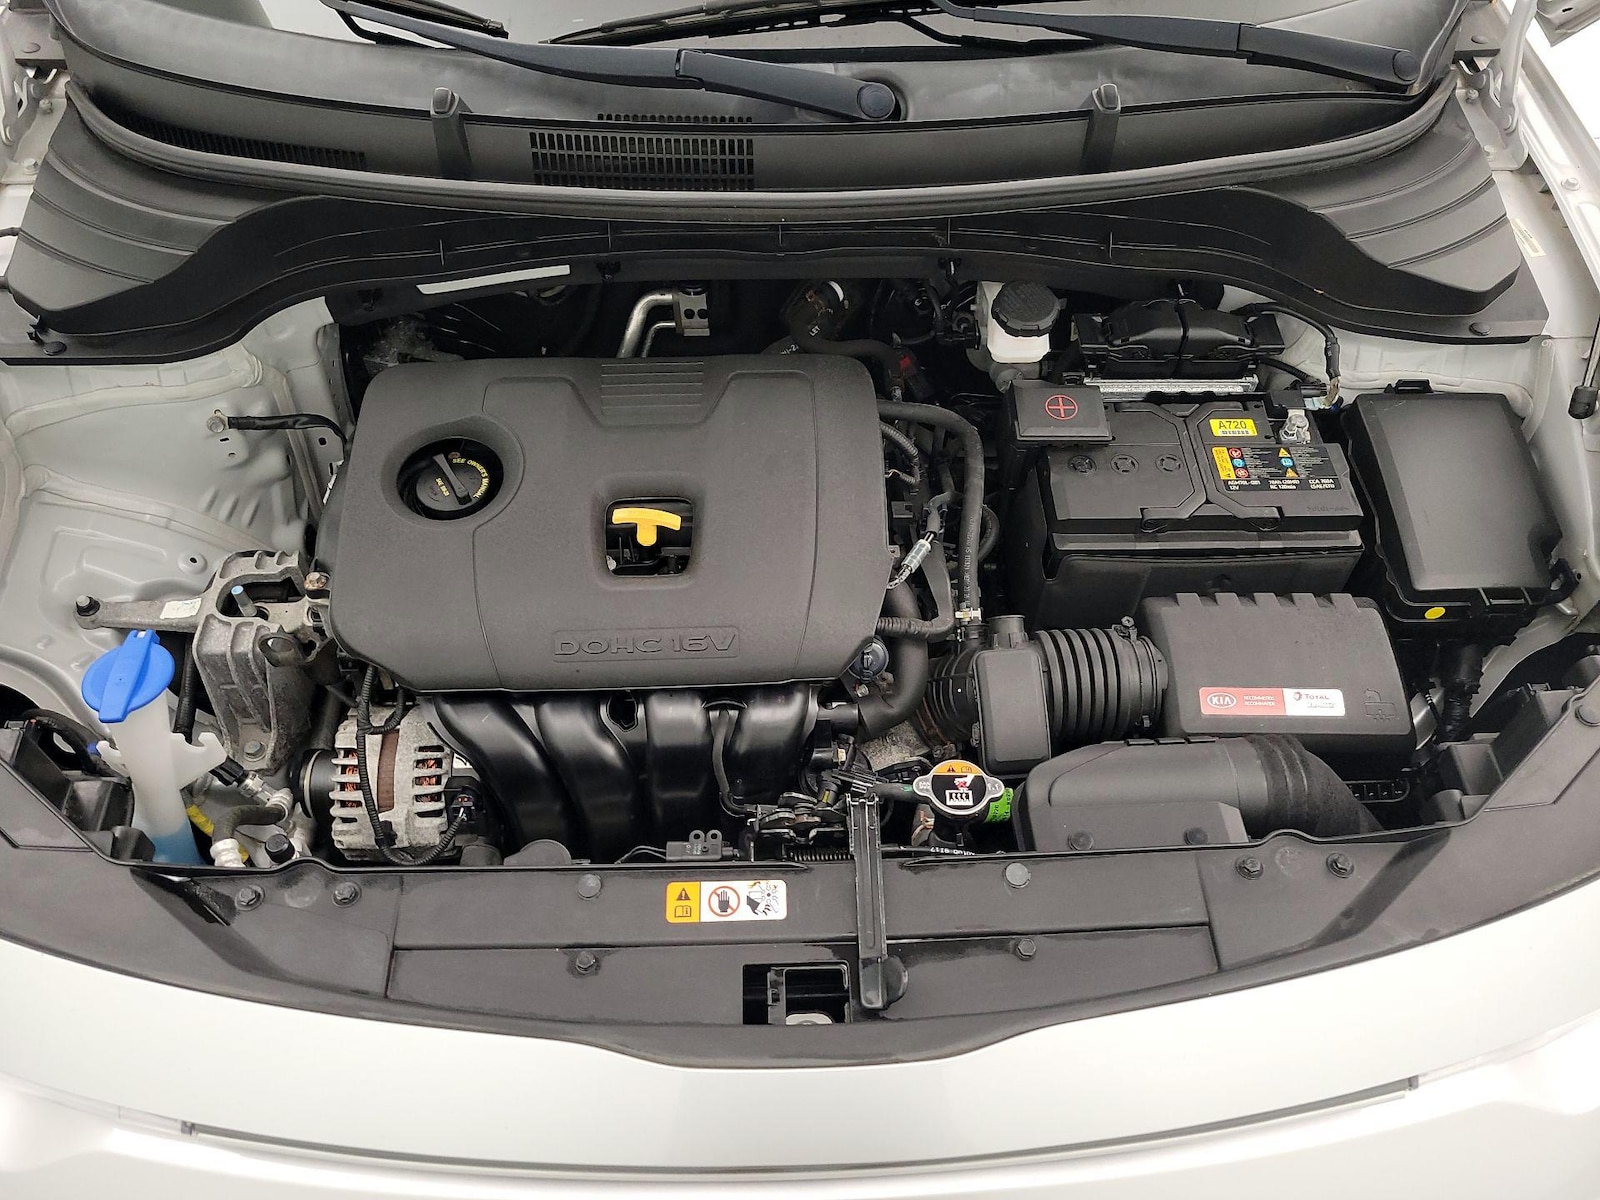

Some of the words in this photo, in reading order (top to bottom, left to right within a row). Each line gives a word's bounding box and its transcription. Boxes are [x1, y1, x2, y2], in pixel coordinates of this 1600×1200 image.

[1218, 420, 1247, 430] A720
[473, 478, 489, 498] MANUAL
[553, 637, 662, 656] DOHC
[671, 633, 736, 653] 16V
[1211, 696, 1231, 705] KIA
